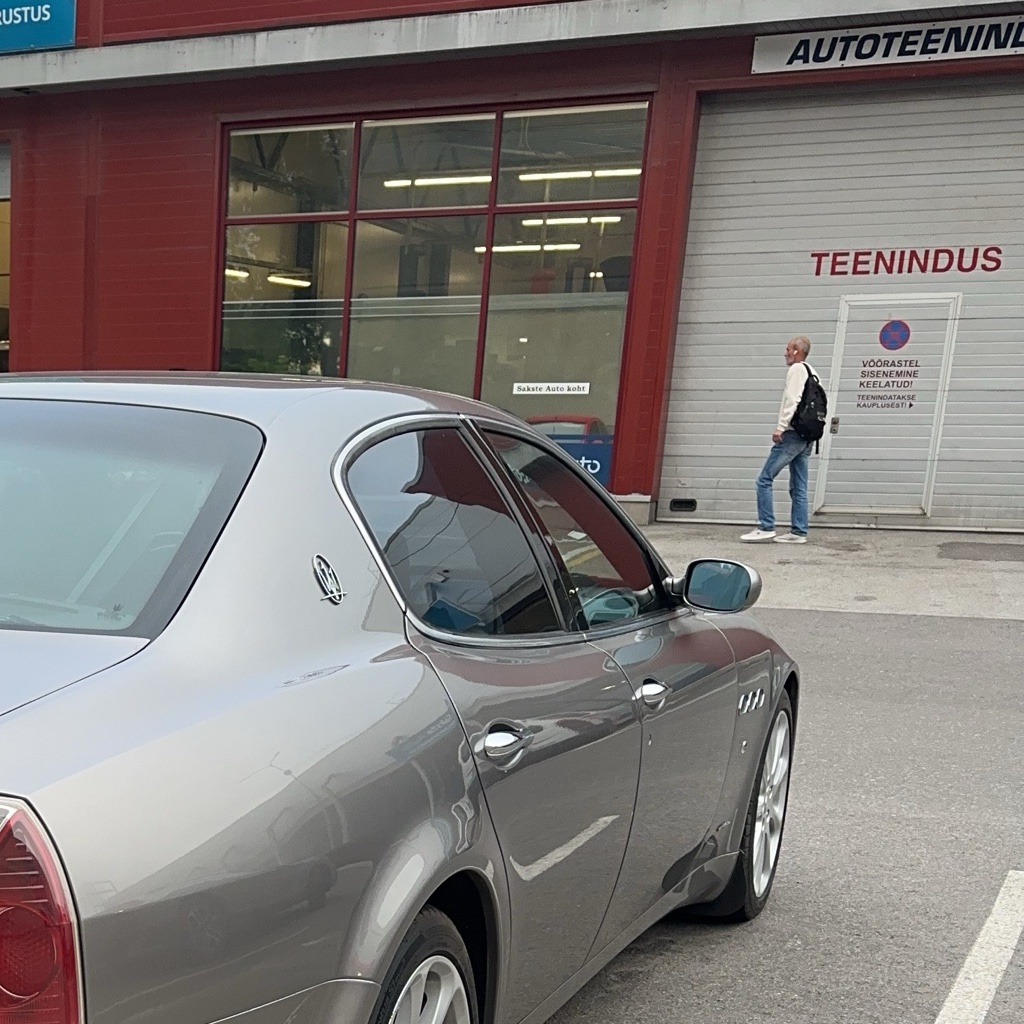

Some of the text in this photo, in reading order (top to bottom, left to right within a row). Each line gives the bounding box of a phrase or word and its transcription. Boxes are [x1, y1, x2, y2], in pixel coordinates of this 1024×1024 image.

[810, 246, 1003, 276] TEENINDUS
[862, 359, 921, 368] VÕÕRASTEL
[860, 370, 919, 378] SISENEMINE
[859, 380, 913, 388] KEELATUD!
